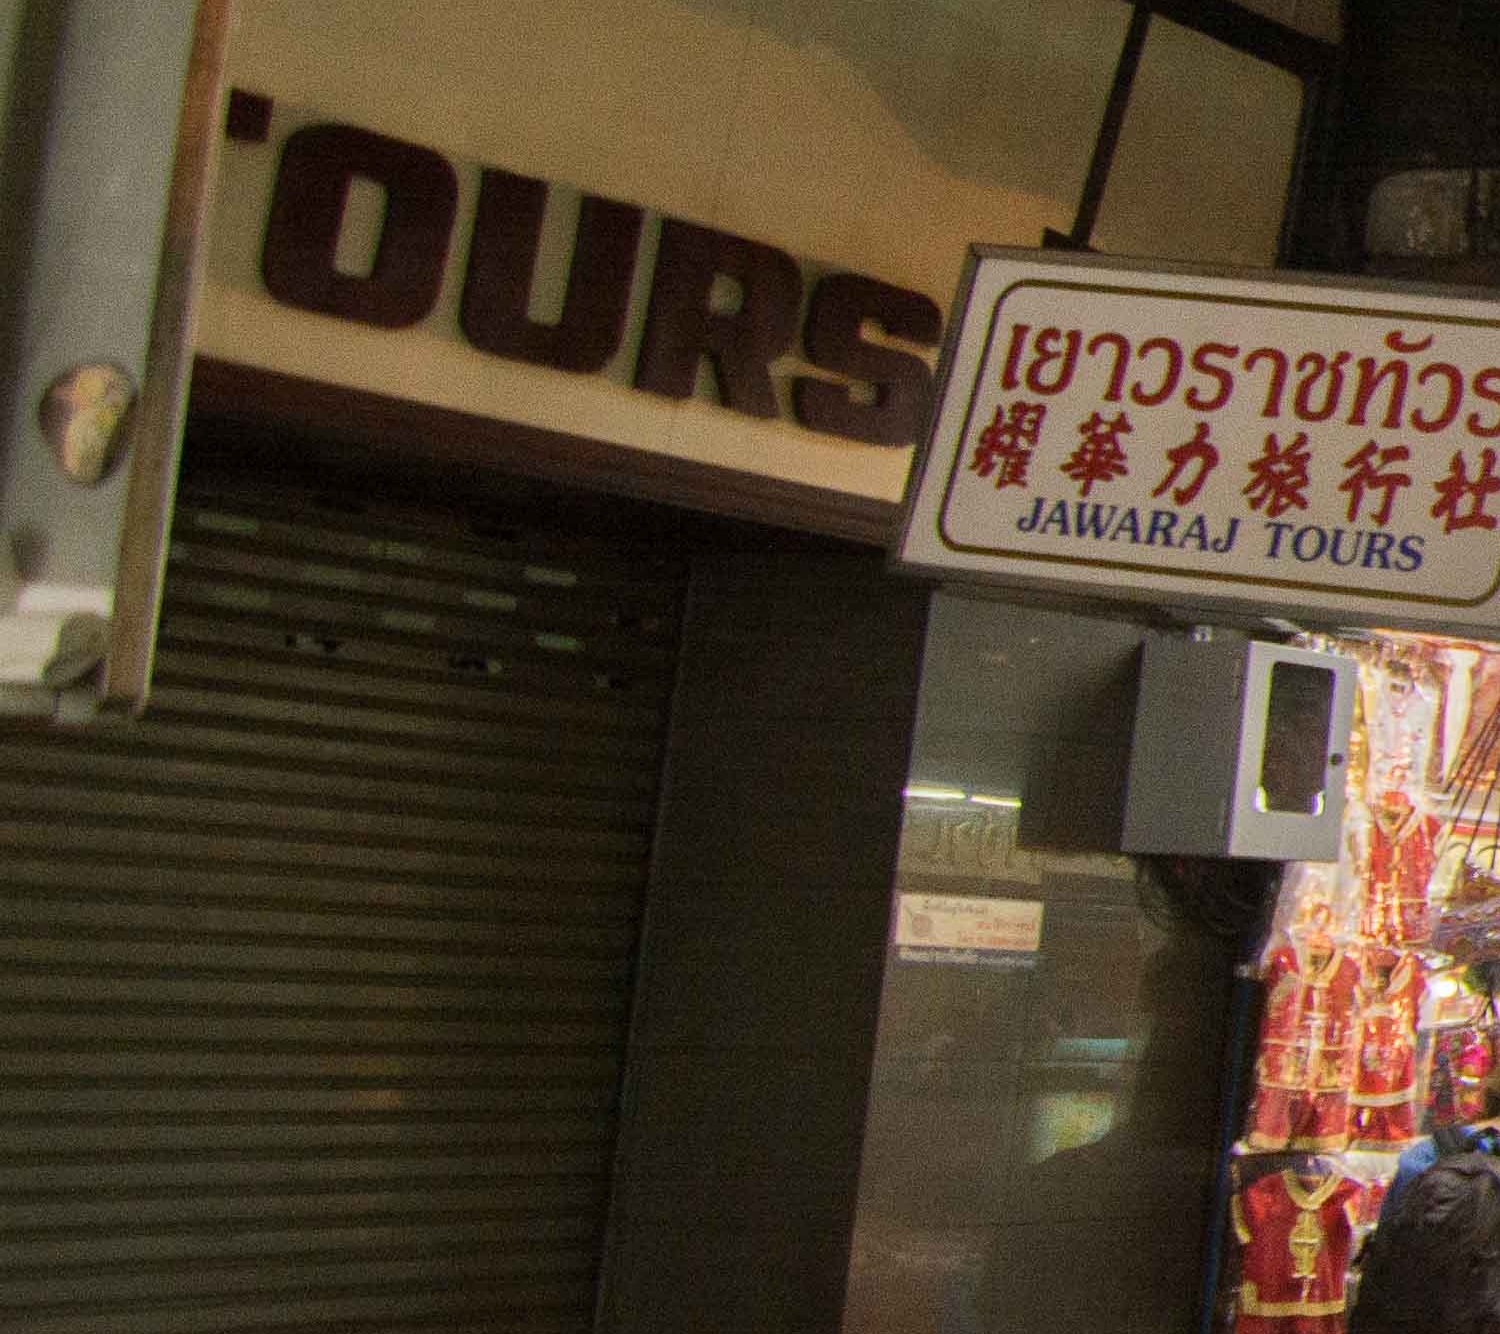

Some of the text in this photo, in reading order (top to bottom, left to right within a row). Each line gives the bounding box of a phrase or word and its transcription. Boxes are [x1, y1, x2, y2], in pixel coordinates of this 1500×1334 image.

[226, 86, 940, 447] OURS
[1017, 496, 1426, 571] JAWARAJ TOURS
